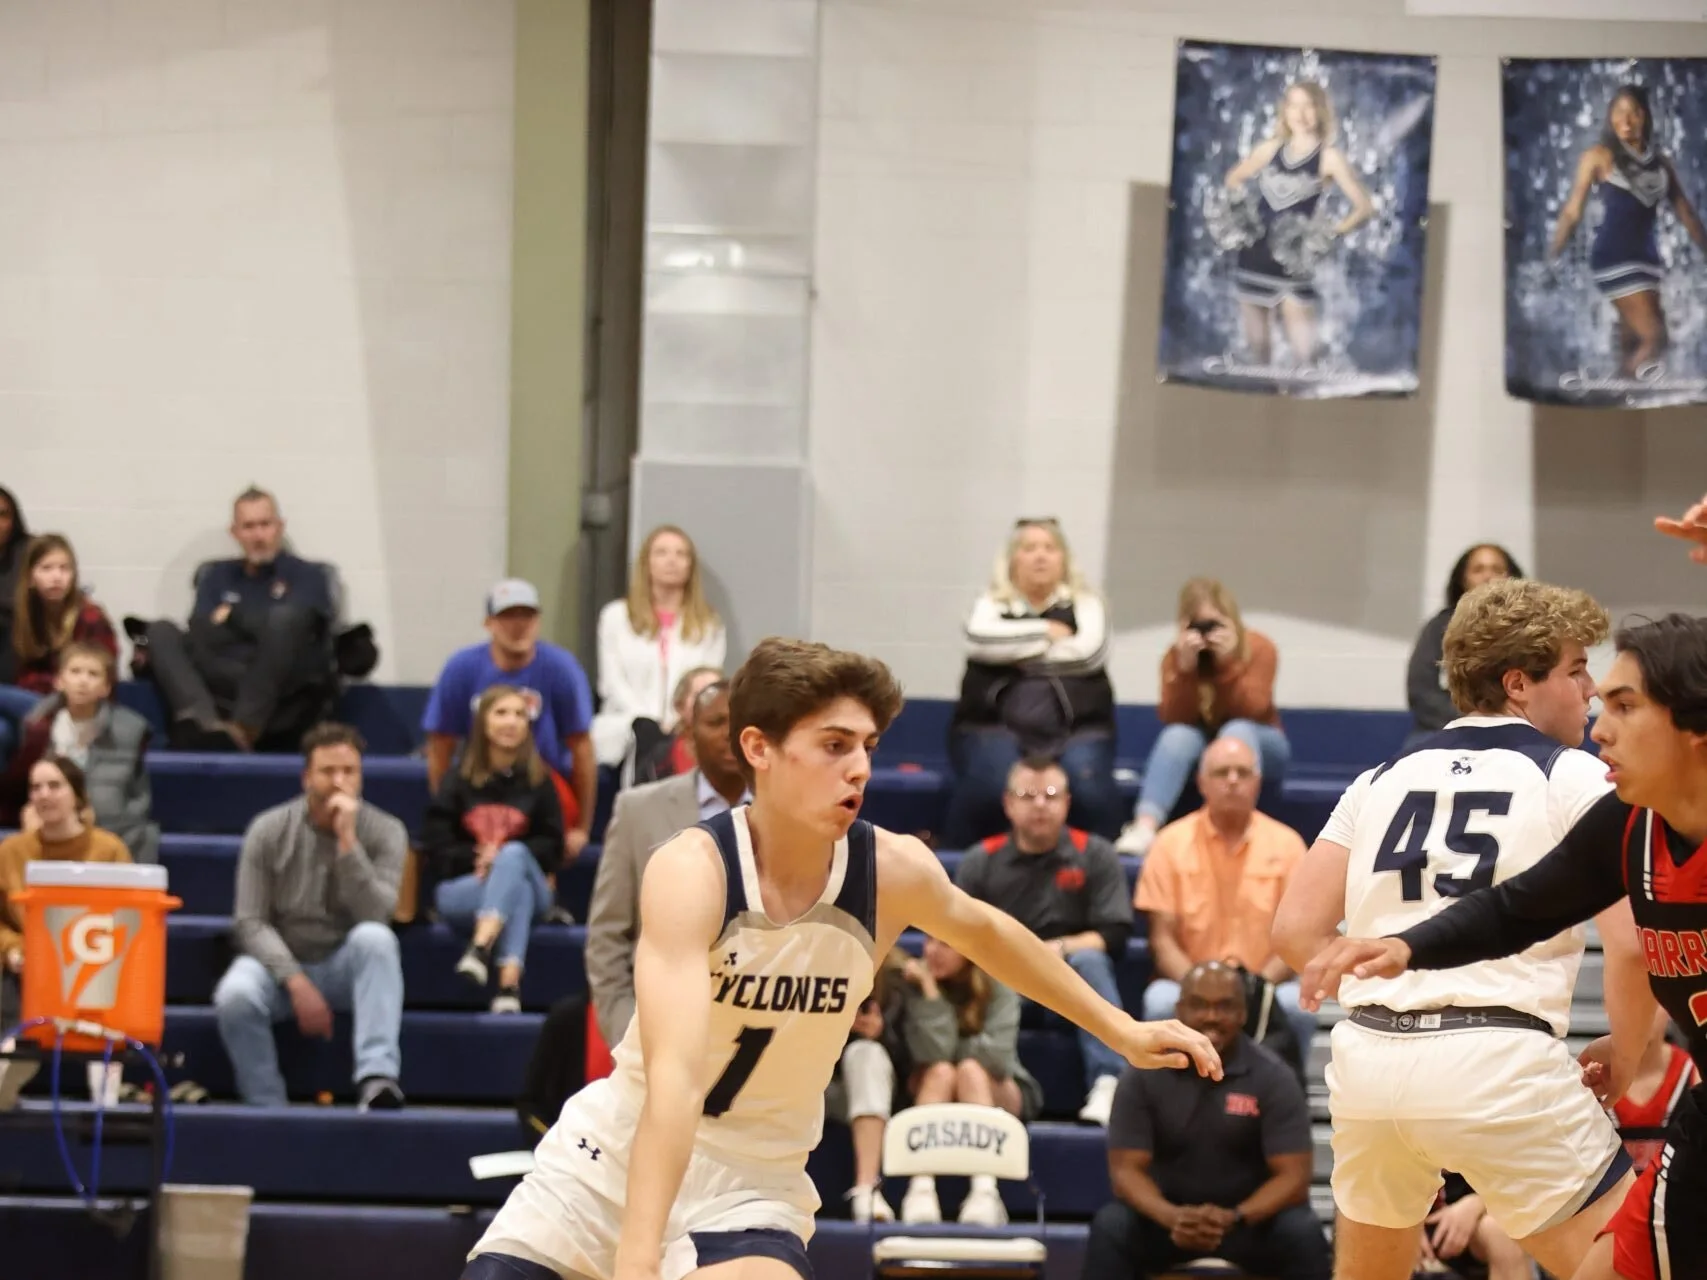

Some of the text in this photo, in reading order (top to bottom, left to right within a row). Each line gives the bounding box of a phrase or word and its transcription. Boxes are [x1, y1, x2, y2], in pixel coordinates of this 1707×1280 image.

[1373, 789, 1514, 903] 45
[71, 914, 115, 965] G
[1635, 925, 1707, 977] ARR
[711, 971, 850, 1014] YCLONES
[702, 1024, 777, 1119] 1
[906, 1120, 1008, 1157] CASADY
